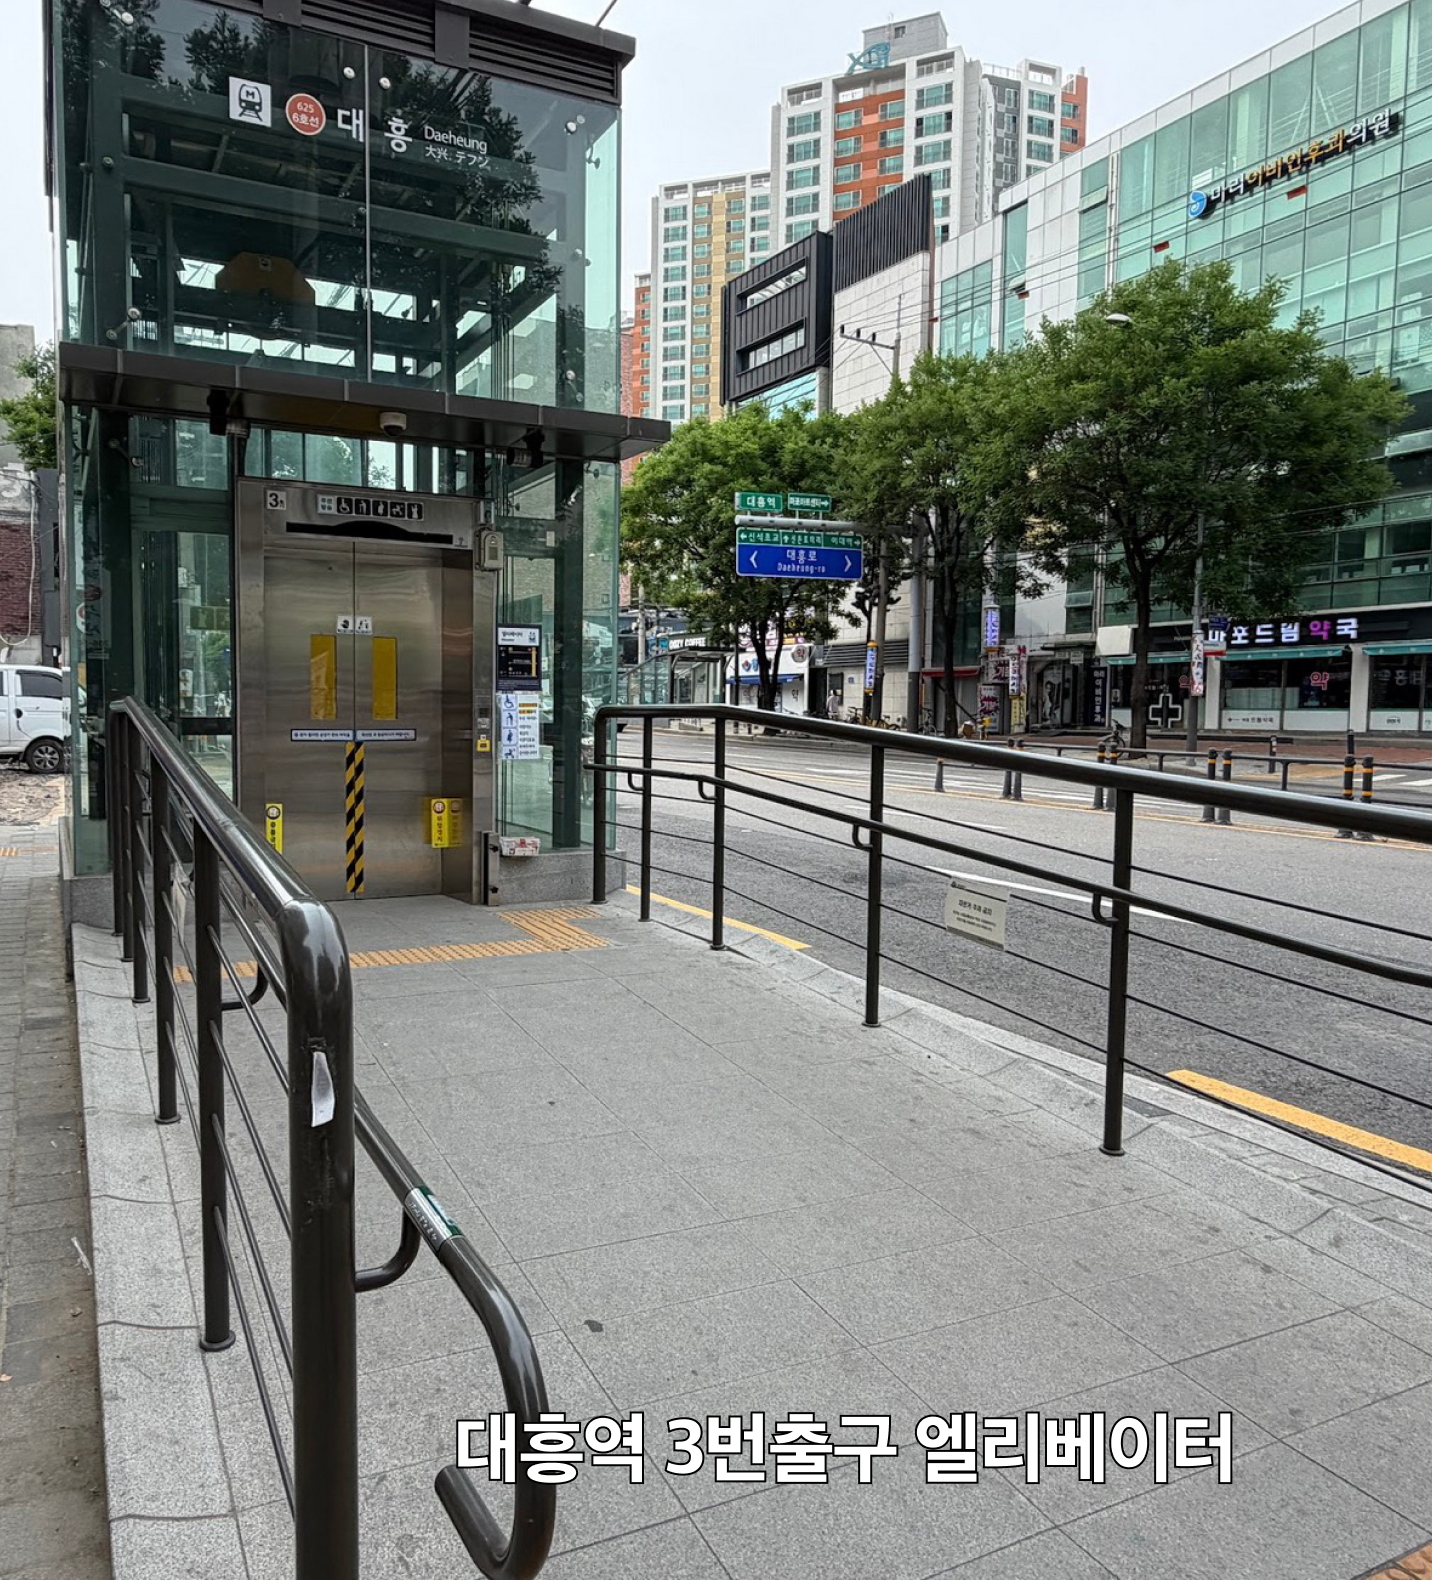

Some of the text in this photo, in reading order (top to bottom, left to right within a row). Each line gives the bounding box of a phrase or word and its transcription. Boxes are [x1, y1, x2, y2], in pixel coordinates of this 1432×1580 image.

[296, 102, 315, 113] 625
[292, 112, 320, 127] 6호선
[423, 126, 488, 154] Daeheung
[746, 496, 776, 508] 대흥역
[786, 549, 817, 564] 대흥로
[777, 562, 826, 574] Daeheung-ro
[1310, 671, 1329, 691] 약
